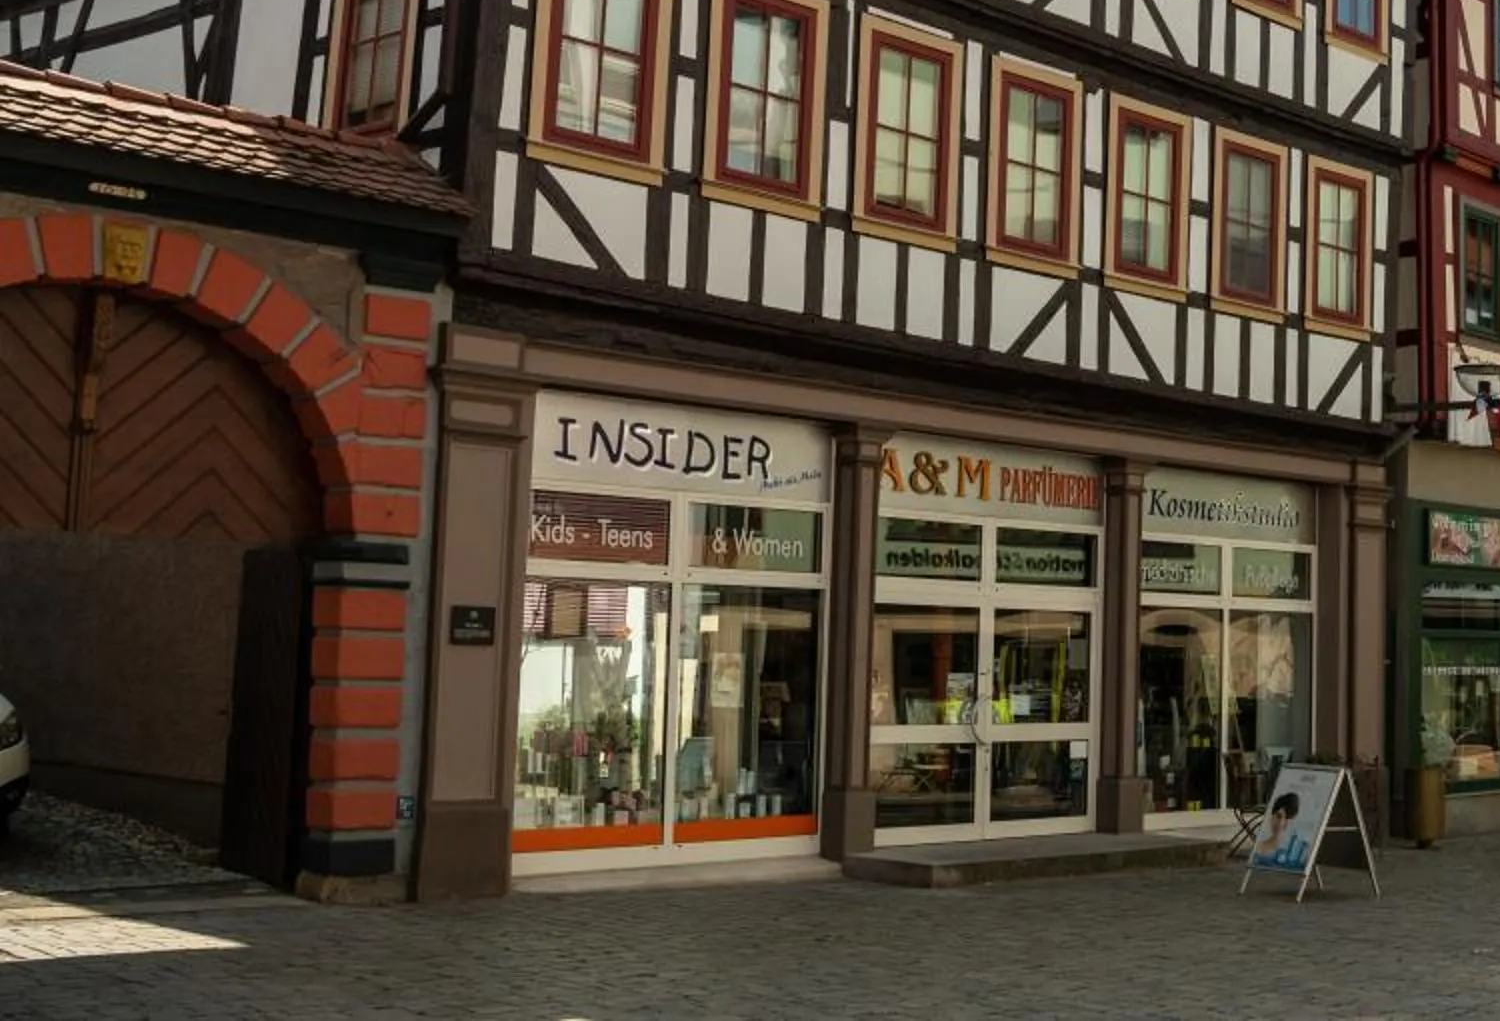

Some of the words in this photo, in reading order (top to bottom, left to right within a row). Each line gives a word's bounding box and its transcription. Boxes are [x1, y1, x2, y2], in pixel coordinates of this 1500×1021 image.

[554, 417, 772, 481] INSIDER
[880, 447, 905, 493] A
[909, 450, 949, 497] &
[955, 454, 993, 502] M
[1147, 487, 1300, 528] Kosmetikstudio
[531, 514, 575, 544] Kids
[597, 518, 654, 548] Teens
[712, 528, 728, 554] &
[733, 528, 804, 557] Women
